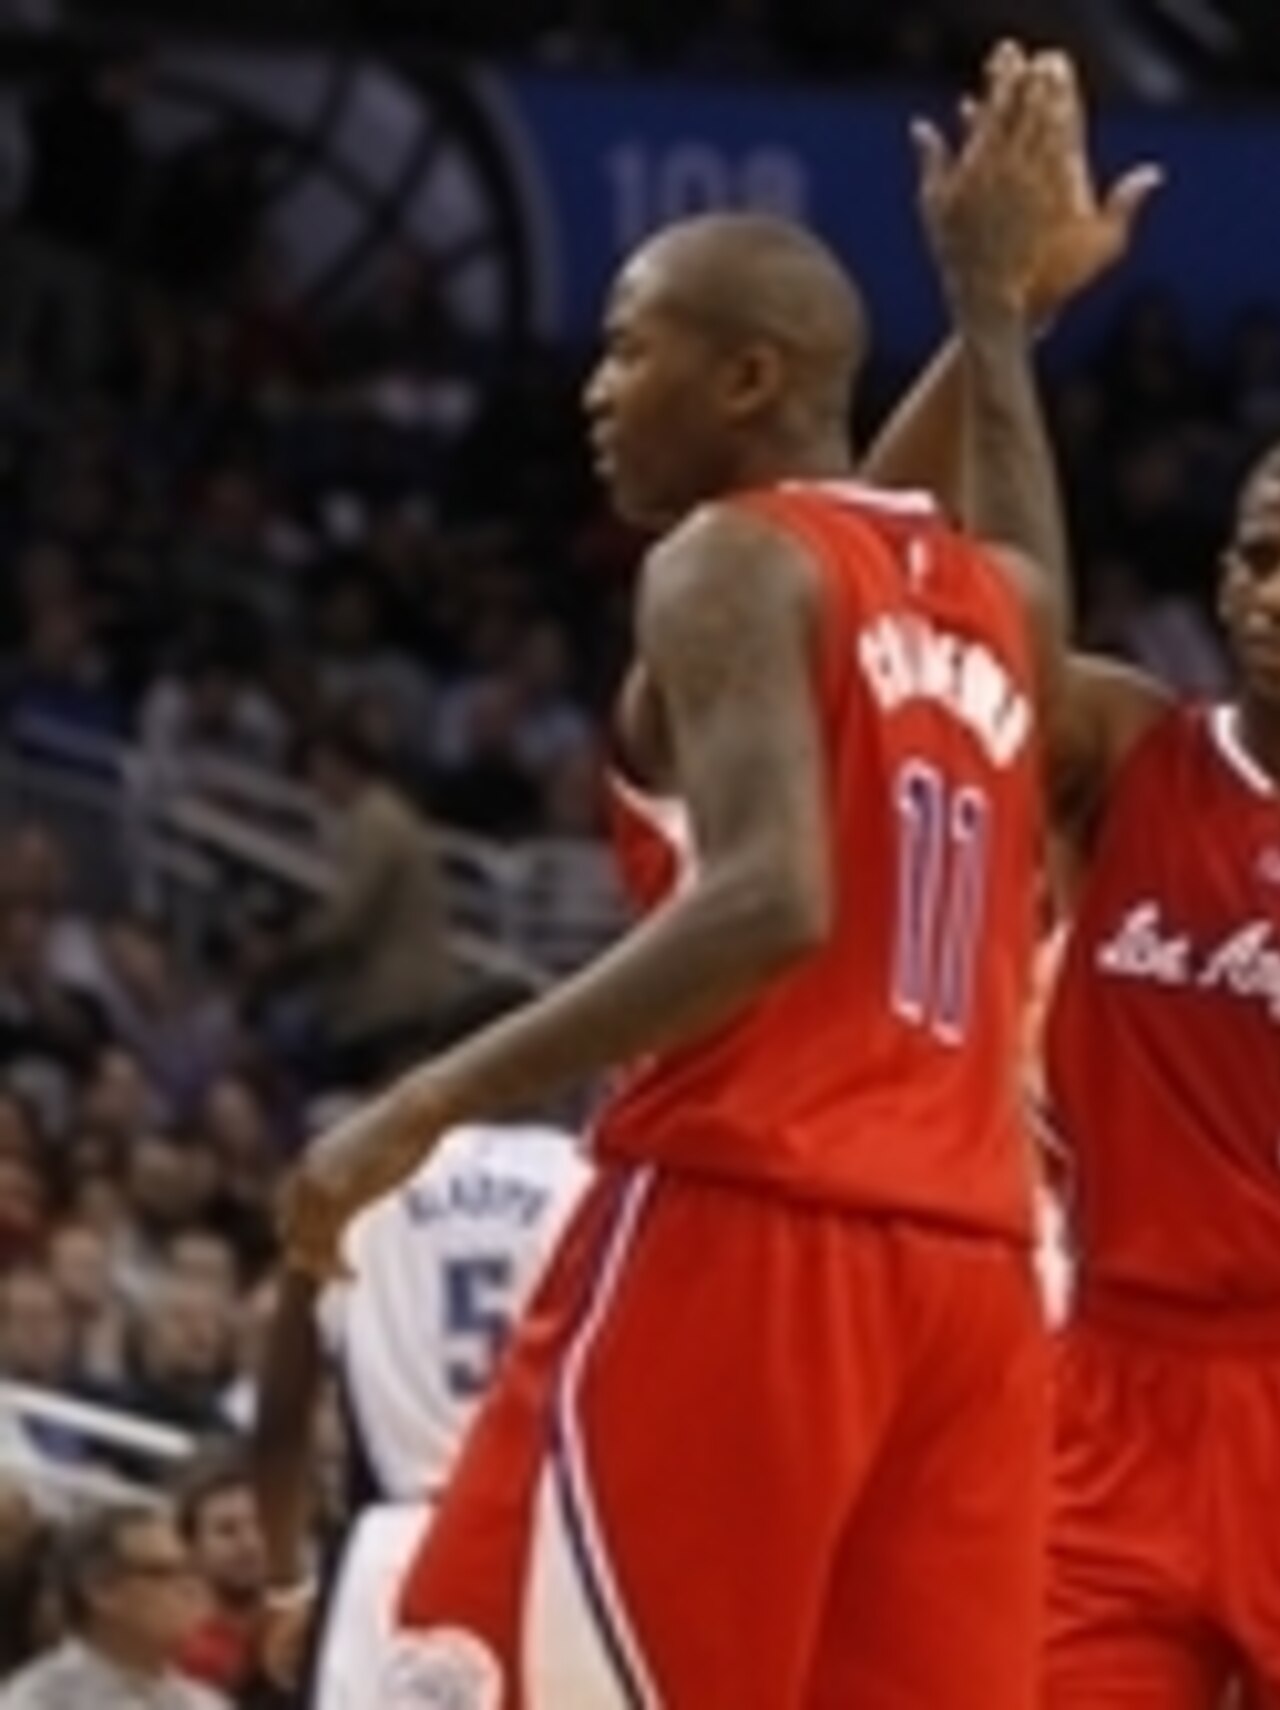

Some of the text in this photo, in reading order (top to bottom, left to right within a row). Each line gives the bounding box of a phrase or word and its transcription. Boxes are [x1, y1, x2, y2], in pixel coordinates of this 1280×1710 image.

[891, 758, 987, 1046] 11
[1098, 900, 1190, 984] Los
[443, 1254, 514, 1398] 5
